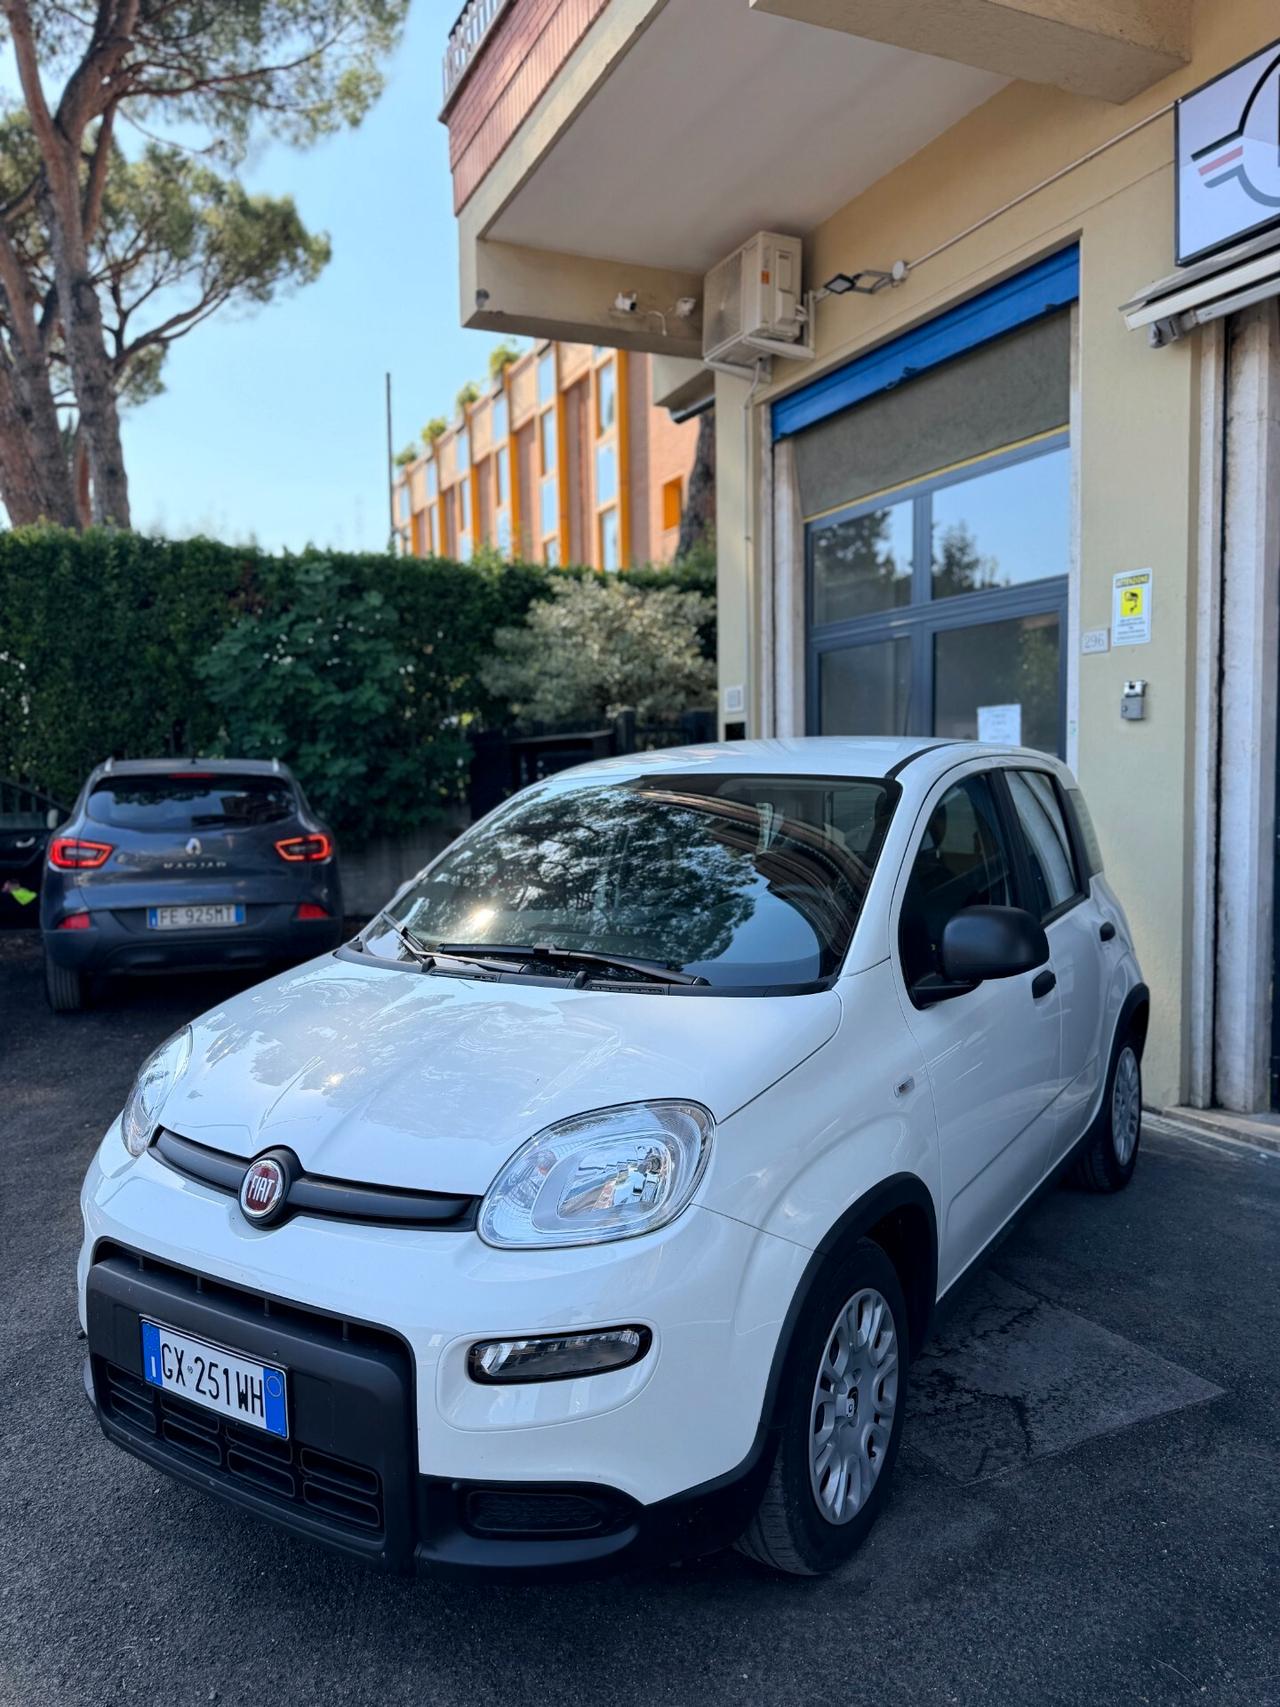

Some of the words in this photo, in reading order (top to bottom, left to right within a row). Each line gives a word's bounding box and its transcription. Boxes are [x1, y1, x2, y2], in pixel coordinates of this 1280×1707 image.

[1084, 632, 1105, 649] 296
[160, 908, 179, 924] FE
[185, 906, 233, 924] 925MT
[248, 1175, 275, 1203] FIAT
[161, 1343, 186, 1387] GX
